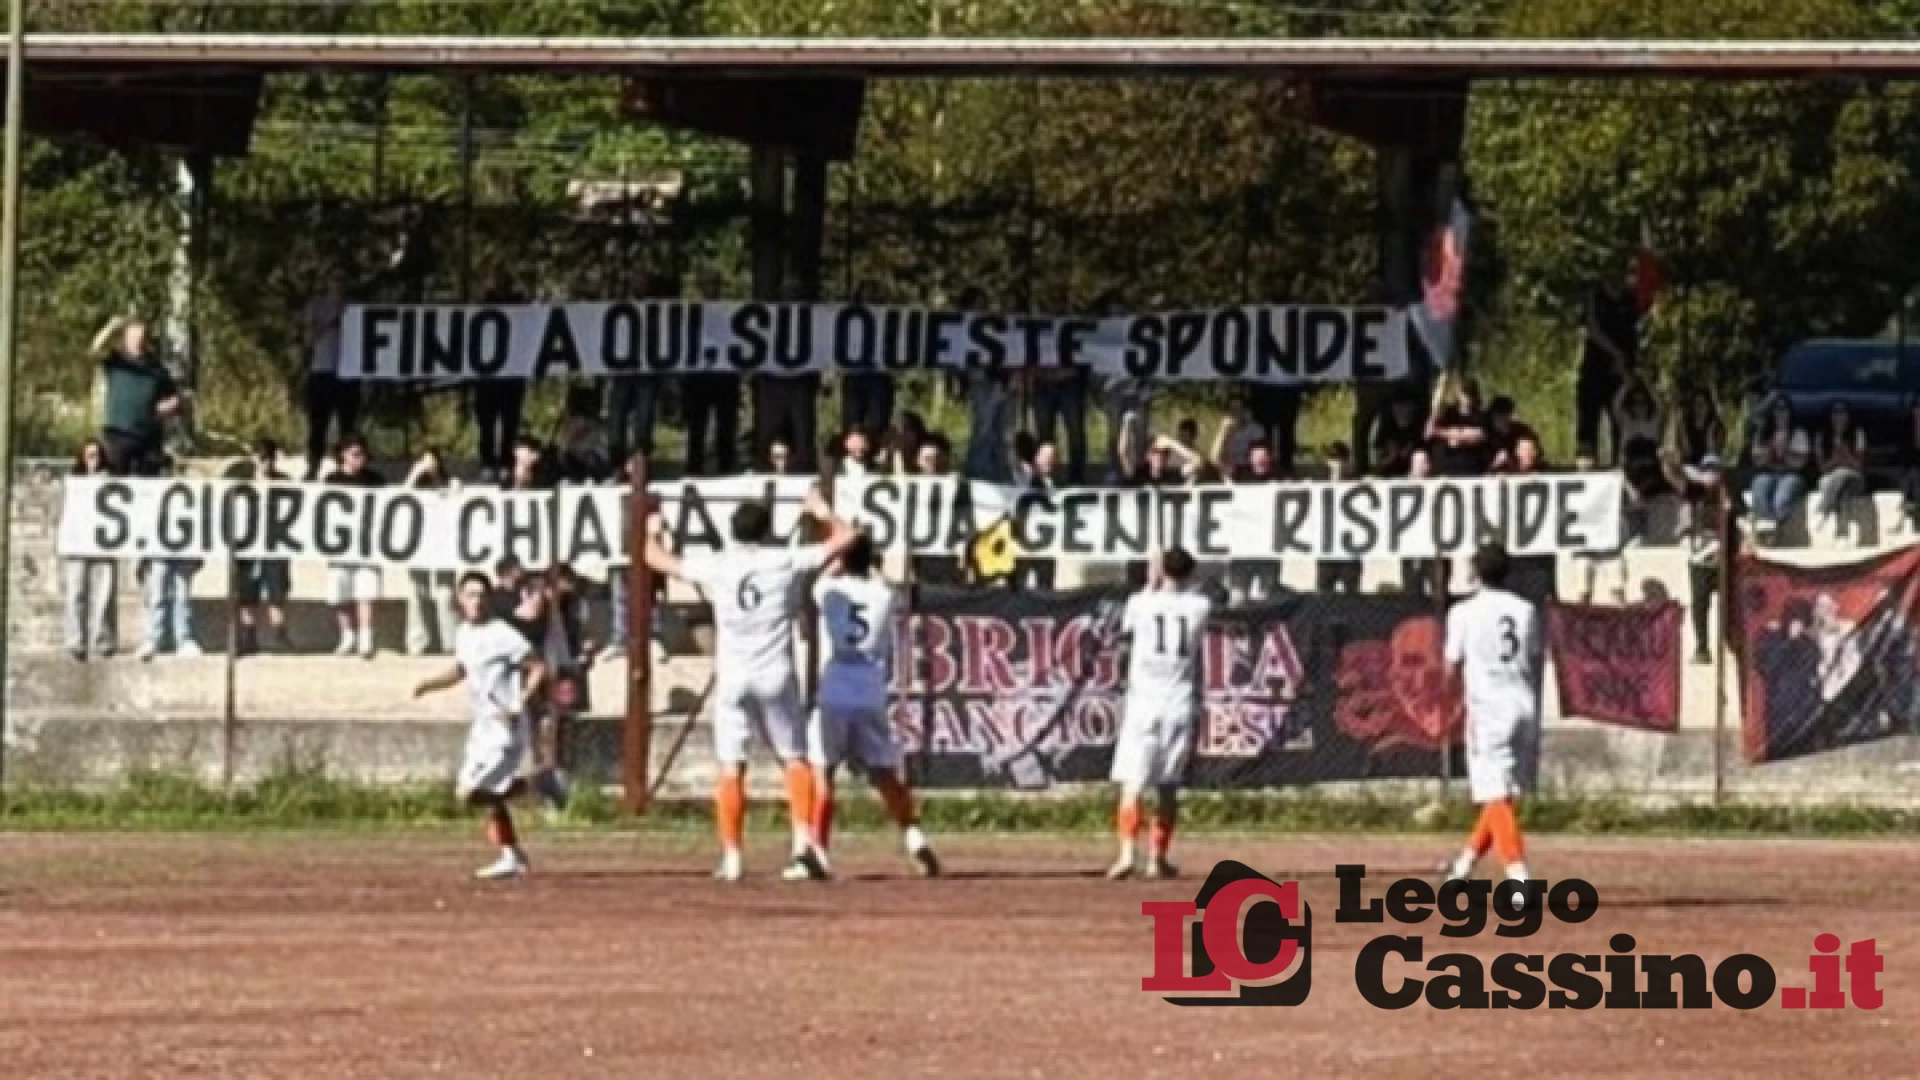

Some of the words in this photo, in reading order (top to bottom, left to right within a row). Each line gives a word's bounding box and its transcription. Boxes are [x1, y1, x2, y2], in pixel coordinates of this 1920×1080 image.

[361, 308, 510, 376] FINO
[534, 307, 582, 376] A
[832, 308, 1097, 373] QUESTE
[1124, 307, 1389, 378] SPONDE
[1013, 490, 1235, 555] GENTE
[1271, 479, 1588, 556] RISPONDE
[737, 573, 764, 611] 6
[847, 604, 870, 645] 5
[1153, 612, 1189, 656] 11
[1499, 614, 1520, 663] 3
[885, 613, 1305, 699] BRIGTA
